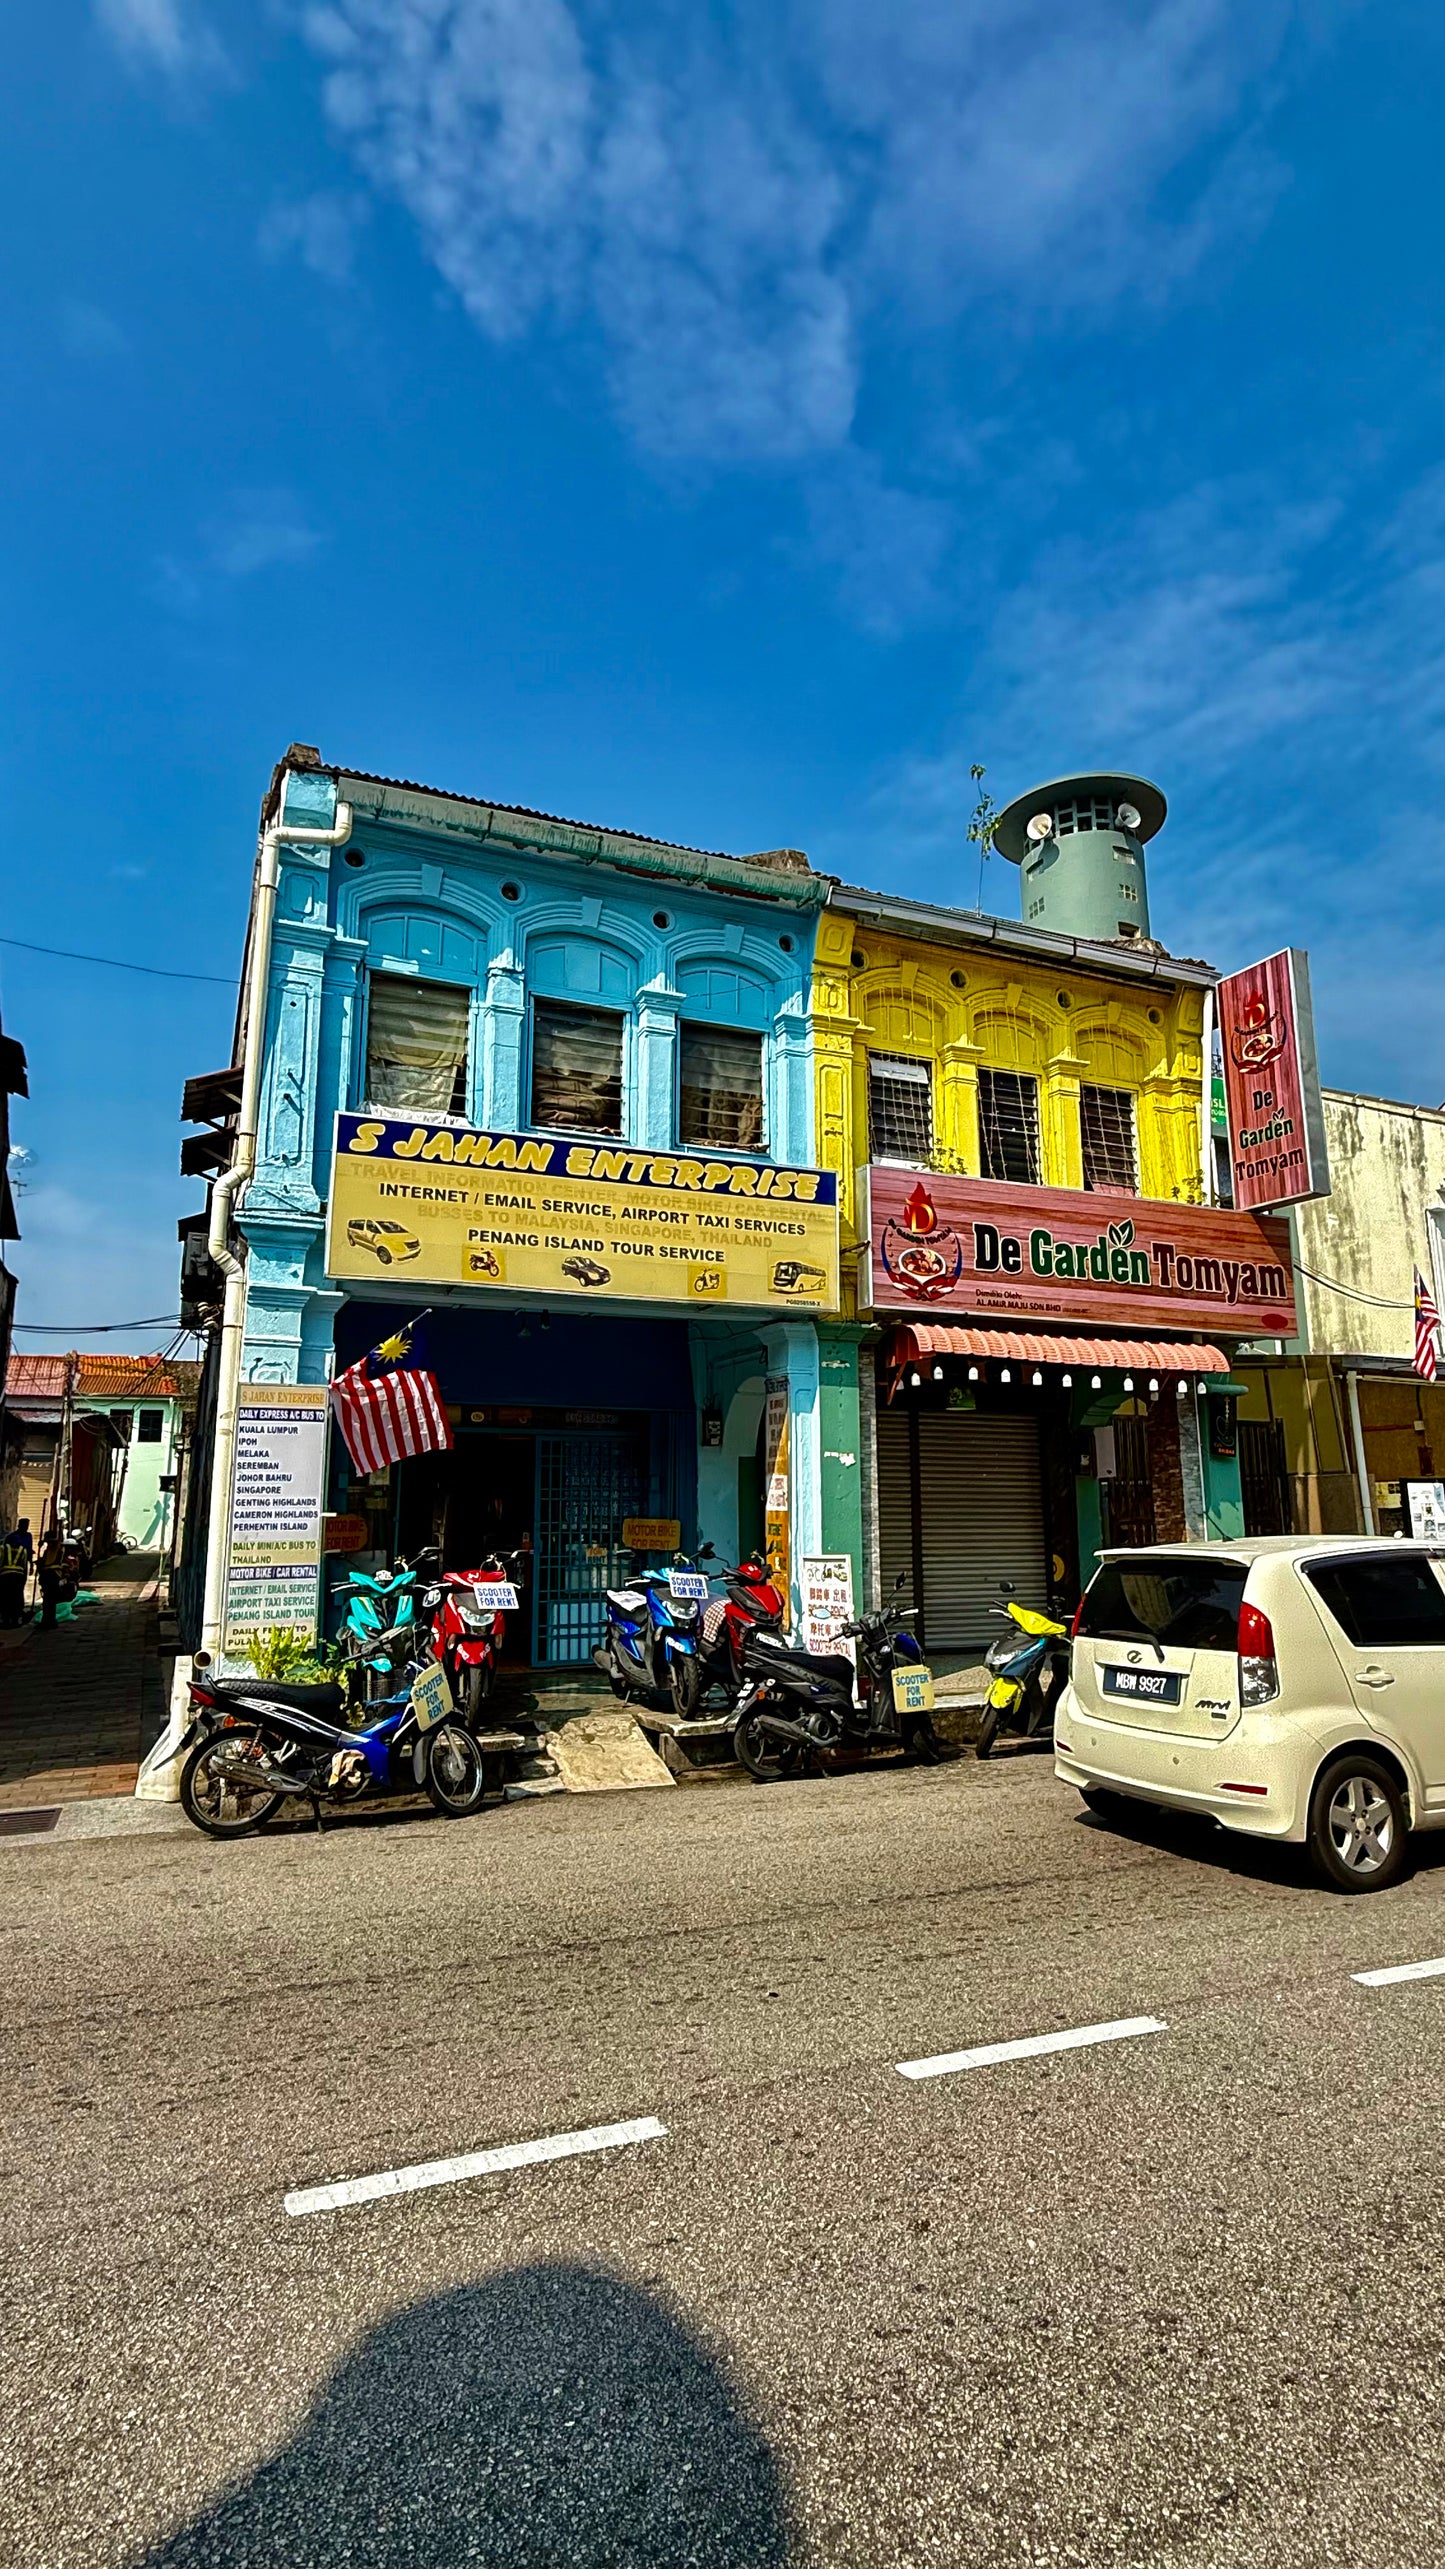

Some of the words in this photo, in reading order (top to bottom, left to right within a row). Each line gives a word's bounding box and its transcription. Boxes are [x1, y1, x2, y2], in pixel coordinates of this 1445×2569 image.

[1252, 1090, 1273, 1112] De
[1239, 1118, 1294, 1150] Garden
[349, 1122, 386, 1153] S
[392, 1128, 554, 1172] JAHAN
[565, 1146, 820, 1201] ENTERPRISE
[1235, 1147, 1304, 1182] Tomyam
[350, 1162, 420, 1182] TRAVEL
[426, 1169, 548, 1195] INFORMATION
[626, 1190, 682, 1209] MOTOR
[686, 1197, 723, 1213] BIKE
[379, 1183, 469, 1203] INTERNET
[474, 1192, 480, 1205] /
[484, 1193, 536, 1210] EMAIL
[541, 1199, 617, 1220] SERVICE,
[620, 1206, 690, 1225] AIRPORT
[695, 1214, 730, 1229] TAXI
[734, 1218, 806, 1236] SERVICES
[417, 1203, 484, 1222] BUSSES
[488, 1211, 511, 1225] TO
[514, 1213, 600, 1236] MALAYSIA,
[604, 1222, 696, 1245] SINGAPORE,
[700, 1231, 773, 1249] THAILAND
[468, 1229, 540, 1248] PENANG
[543, 1235, 605, 1252] ISLAND
[610, 1241, 655, 1257] TOUR
[658, 1245, 725, 1263] SERVICE
[972, 1220, 1023, 1275] De
[1028, 1226, 1152, 1287] Garden
[1151, 1240, 1288, 1305] Tomyam
[975, 1299, 987, 1307] AL
[987, 1299, 1007, 1308] AMIR
[1007, 1301, 1028, 1310] MAJU
[1029, 1302, 1045, 1311] SDN
[1045, 1303, 1061, 1312] BHD
[242, 1391, 248, 1399] S
[249, 1391, 275, 1402] JAHAN
[277, 1391, 325, 1404] ENTERPRISE
[239, 1410, 258, 1419] DAILY
[259, 1410, 288, 1420] EXPRESS
[301, 1411, 315, 1420] BUS
[315, 1411, 325, 1420] TO
[239, 1425, 265, 1434] KUALA
[267, 1426, 299, 1435] LUMPUR
[238, 1437, 258, 1446] IPOH
[237, 1450, 270, 1458] MELAKA
[236, 1462, 280, 1470] SEREMBAN
[236, 1474, 264, 1482] JOHOR
[265, 1474, 292, 1482] BAHRU
[236, 1486, 282, 1494] SINGAPORE
[235, 1498, 271, 1507] GENTING
[272, 1498, 317, 1507] HIGHLANDS
[233, 1511, 273, 1520] CAMERON
[274, 1511, 319, 1519] HIGHLANDS
[233, 1523, 279, 1532] PERHENTIN
[279, 1522, 308, 1531] ISLAND
[626, 1525, 656, 1537] MOTOR
[657, 1524, 678, 1537] BIKE
[232, 1542, 256, 1551] DAILY
[288, 1541, 304, 1550] BUS
[305, 1541, 317, 1550] TO
[631, 1539, 648, 1549] FOR
[232, 1555, 272, 1565] THAILAND
[229, 1568, 254, 1579] MOTOR
[255, 1567, 272, 1578] BIKE
[276, 1567, 290, 1577] CAR
[291, 1566, 317, 1577] RENTAL
[671, 1576, 704, 1588] SCOOTER
[229, 1585, 263, 1596] INTERNET
[267, 1584, 288, 1594] EMAIL
[288, 1583, 317, 1593] SERVICE
[477, 1587, 513, 1597] SCOOTER
[673, 1586, 688, 1596] FOR
[688, 1587, 706, 1598] RENT
[228, 1598, 263, 1609] AIRPORT
[264, 1597, 282, 1608] TAXI
[282, 1596, 315, 1606] SERVICE
[480, 1597, 496, 1607] FOR
[496, 1597, 516, 1607] RENT
[227, 1610, 261, 1621] PENANG
[262, 1609, 292, 1619] ISLAND
[293, 1608, 315, 1618] TOUR
[232, 1627, 260, 1636] DAILY
[295, 1625, 307, 1633] TO
[415, 1673, 444, 1700] SCOOTER
[896, 1674, 930, 1687] SCOOTER
[1138, 1676, 1167, 1695] 9927
[906, 1685, 921, 1697] FOR
[426, 1691, 440, 1708] FOR
[906, 1696, 926, 1708] RENT
[428, 1700, 445, 1721] RENT
